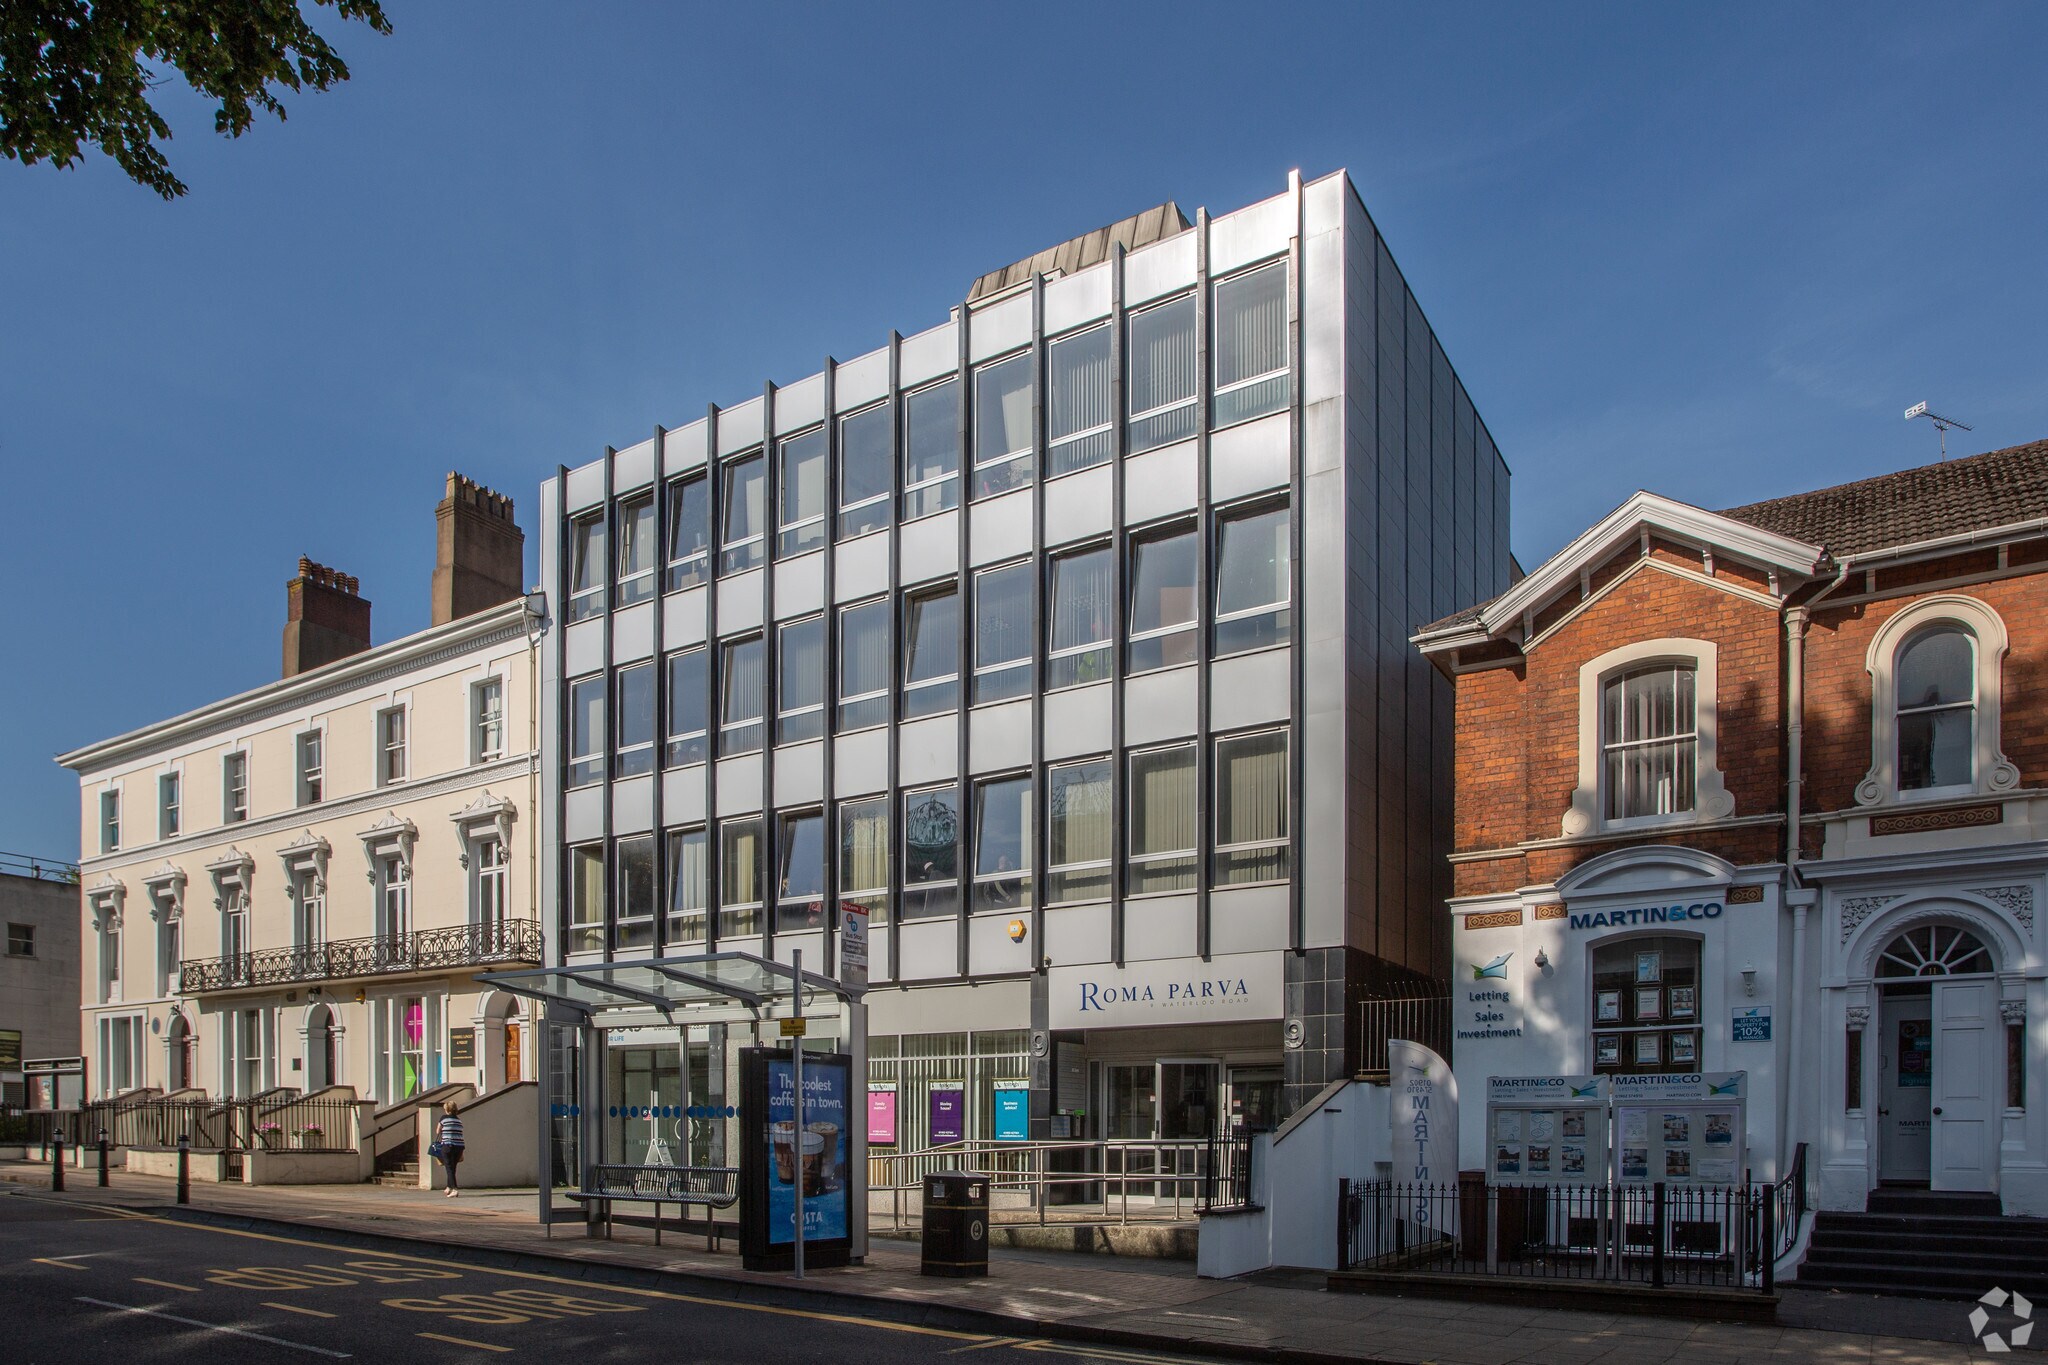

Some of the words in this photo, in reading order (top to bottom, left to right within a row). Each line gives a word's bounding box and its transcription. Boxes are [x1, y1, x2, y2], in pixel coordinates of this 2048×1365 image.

[1570, 902, 1722, 930] MARTIN&CO
[1079, 982, 1154, 1011] ROMA
[1168, 978, 1248, 998] PARVA
[1469, 990, 1510, 1002] Letting
[1475, 1011, 1504, 1022] Sales
[1284, 1019, 1305, 1048] 9
[1457, 1028, 1522, 1039] Investment
[1740, 1027, 1763, 1036] 10%
[1031, 1031, 1048, 1057] 9
[1492, 1078, 1564, 1087] MARTIN&CO
[1615, 1075, 1701, 1084] MARTIN&CO
[770, 1091, 805, 1106] coffes
[807, 1093, 816, 1107] in
[818, 1096, 843, 1108] town.
[790, 1212, 823, 1224] CSTA
